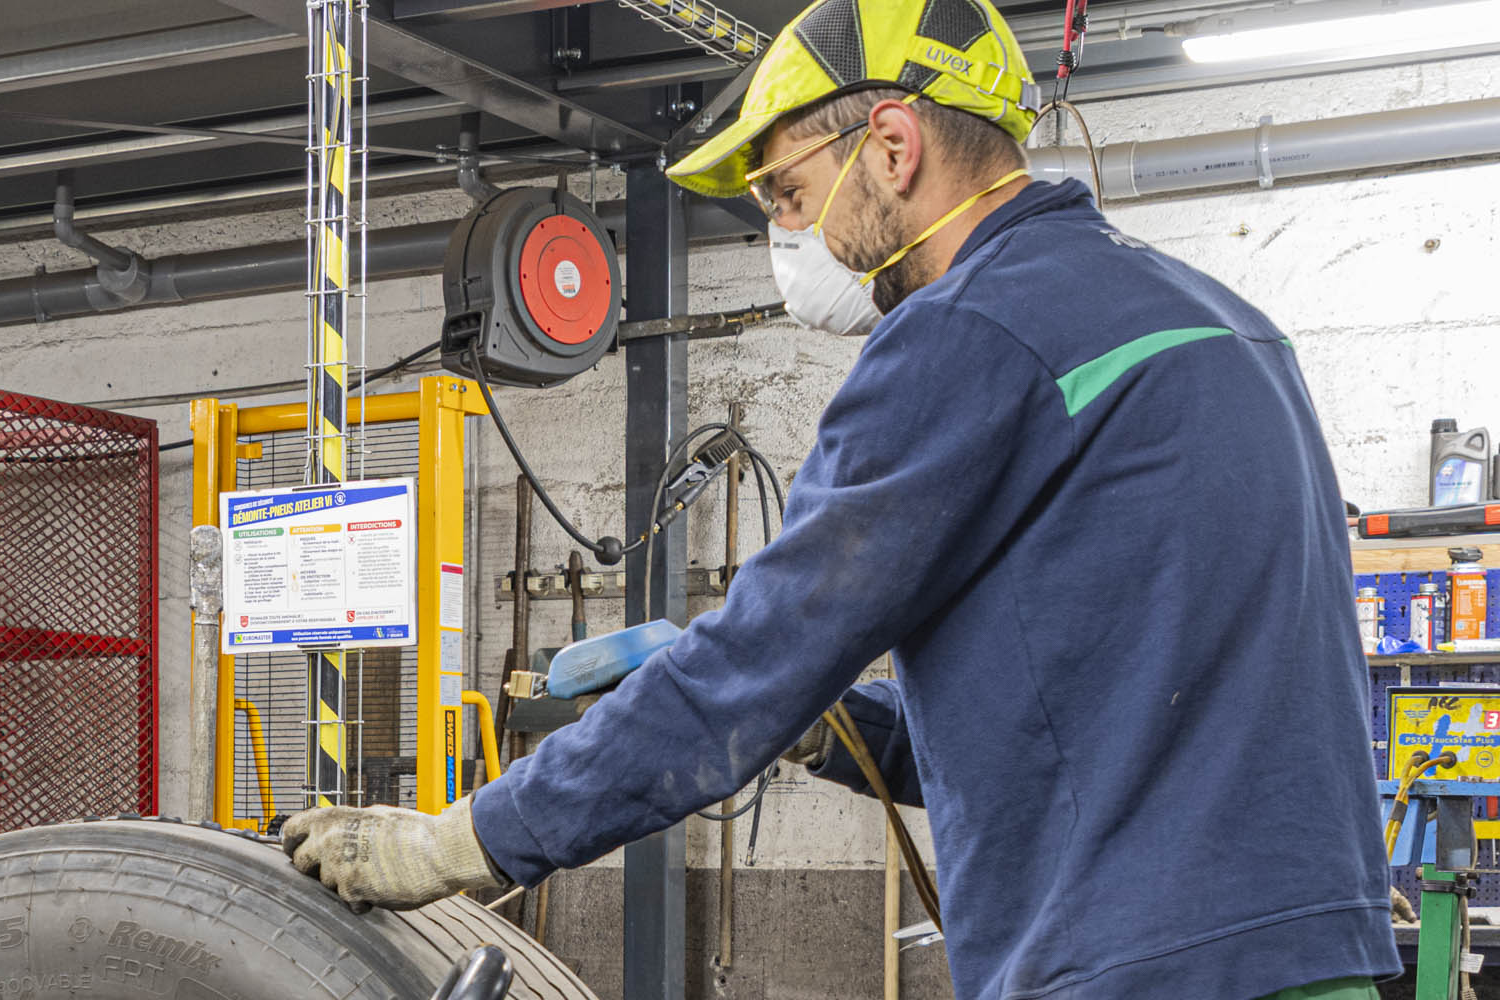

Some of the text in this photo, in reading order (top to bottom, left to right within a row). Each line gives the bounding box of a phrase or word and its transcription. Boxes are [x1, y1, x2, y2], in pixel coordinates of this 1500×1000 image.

[926, 45, 973, 76] uvex
[232, 502, 294, 525] DÉMONTE-PNEUS
[294, 498, 325, 512] ATELIER
[349, 520, 397, 530] INTERDICTIONS
[1486, 712, 1499, 728] 3
[107, 919, 223, 976] Remix
[101, 955, 165, 994] FRT
